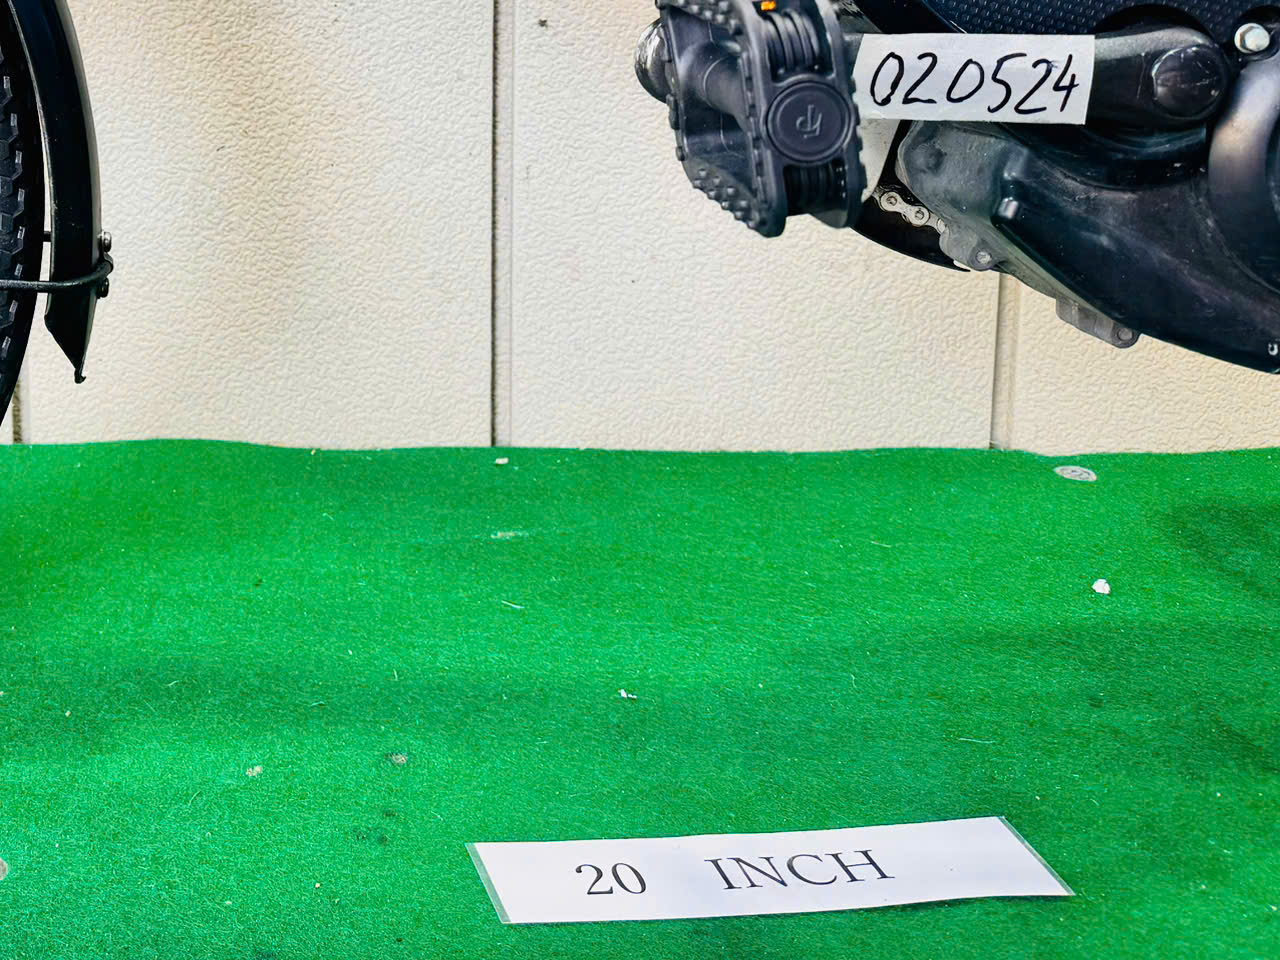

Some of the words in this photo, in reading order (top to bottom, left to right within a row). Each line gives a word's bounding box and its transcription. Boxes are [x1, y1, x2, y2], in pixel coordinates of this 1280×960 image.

[870, 52, 1079, 115] 020524
[574, 862, 647, 895] 20
[704, 848, 894, 890] INCH
